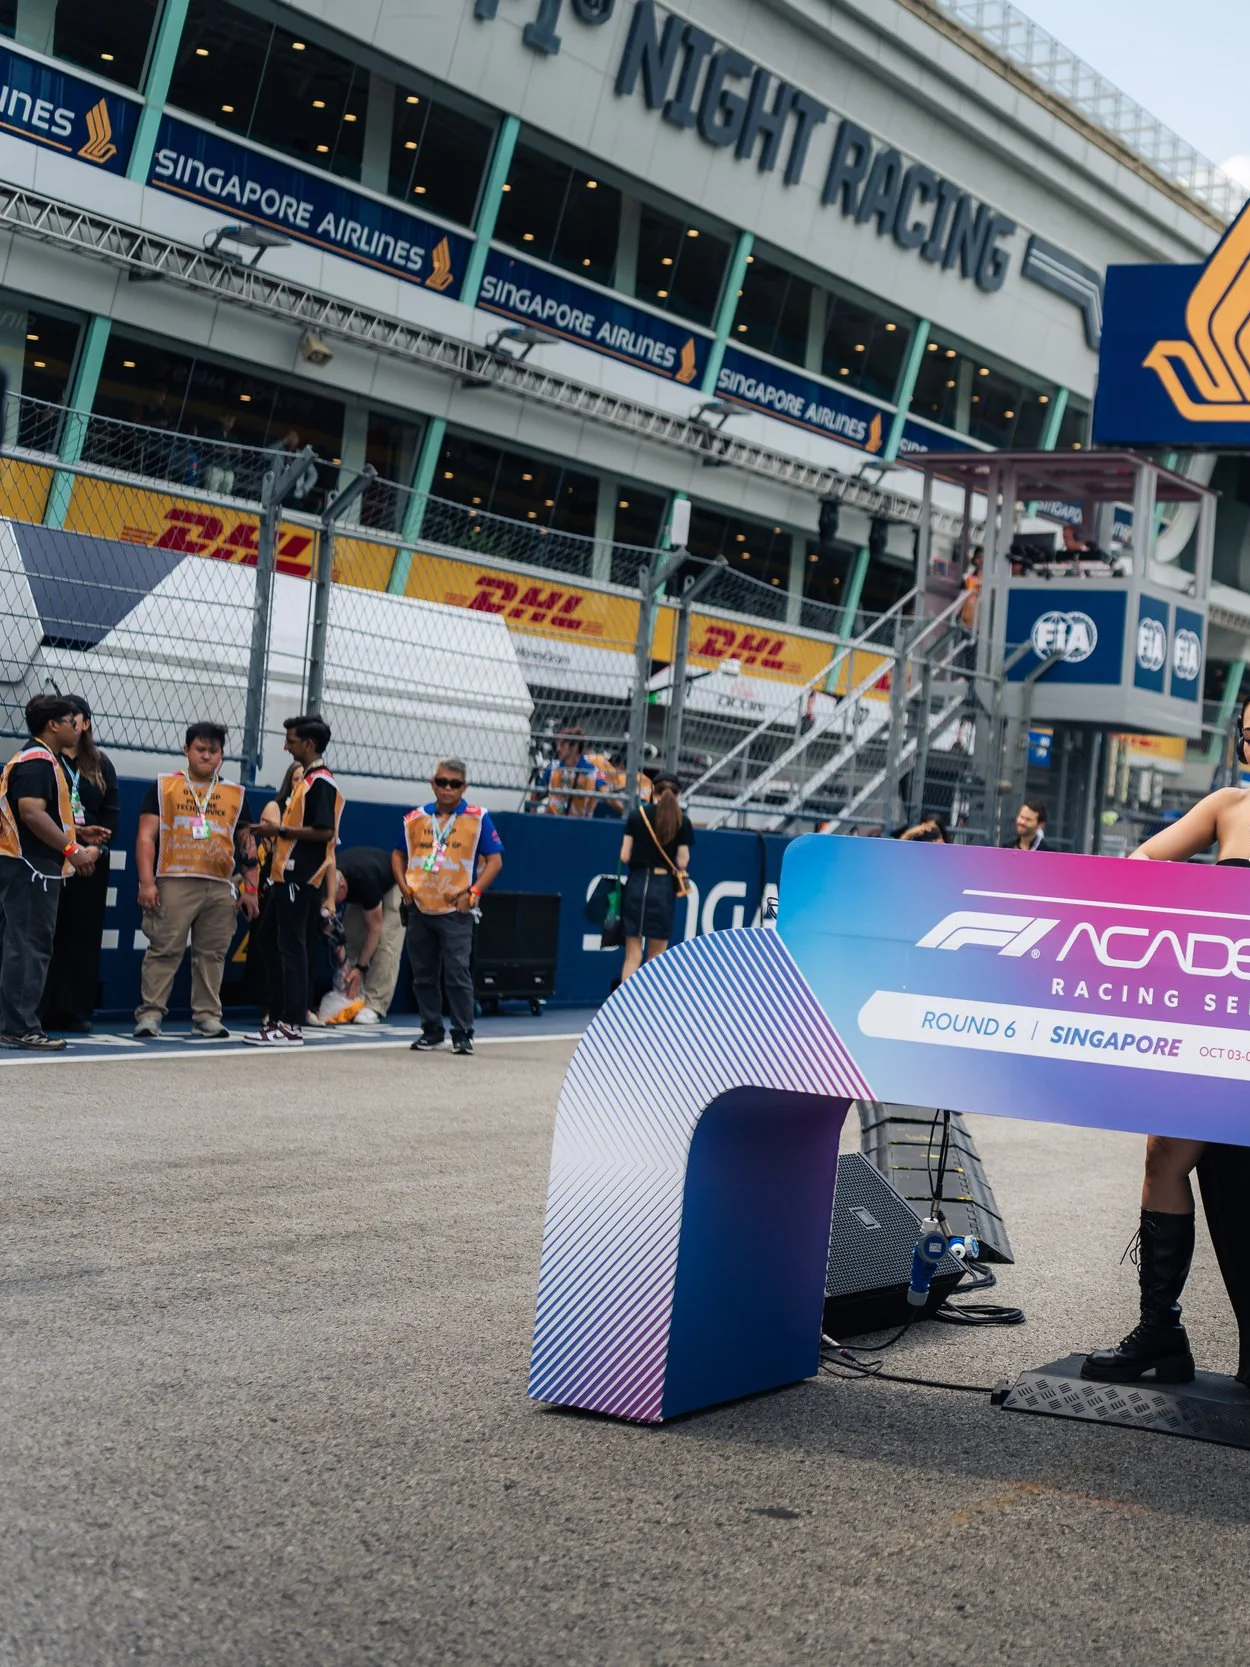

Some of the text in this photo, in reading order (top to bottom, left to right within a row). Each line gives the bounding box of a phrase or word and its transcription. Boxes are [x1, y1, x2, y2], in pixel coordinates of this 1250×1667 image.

[614, 0, 1017, 293] NIGHT RACING
[154, 148, 426, 271] SINGAPORE AIRLINES
[479, 275, 678, 368] SINGAPORE AIRLINES
[717, 368, 868, 440] SINGAPORE AIRLINES
[467, 575, 583, 630] DHL
[698, 625, 786, 670] DHL
[1036, 611, 1092, 653] FIA
[1051, 977, 1180, 1008] RACING
[920, 1010, 1000, 1037] ROUND
[1003, 1020, 1017, 1039] 6
[1049, 1025, 1184, 1058] SINGAPORE
[1199, 1046, 1225, 1060] OCT
